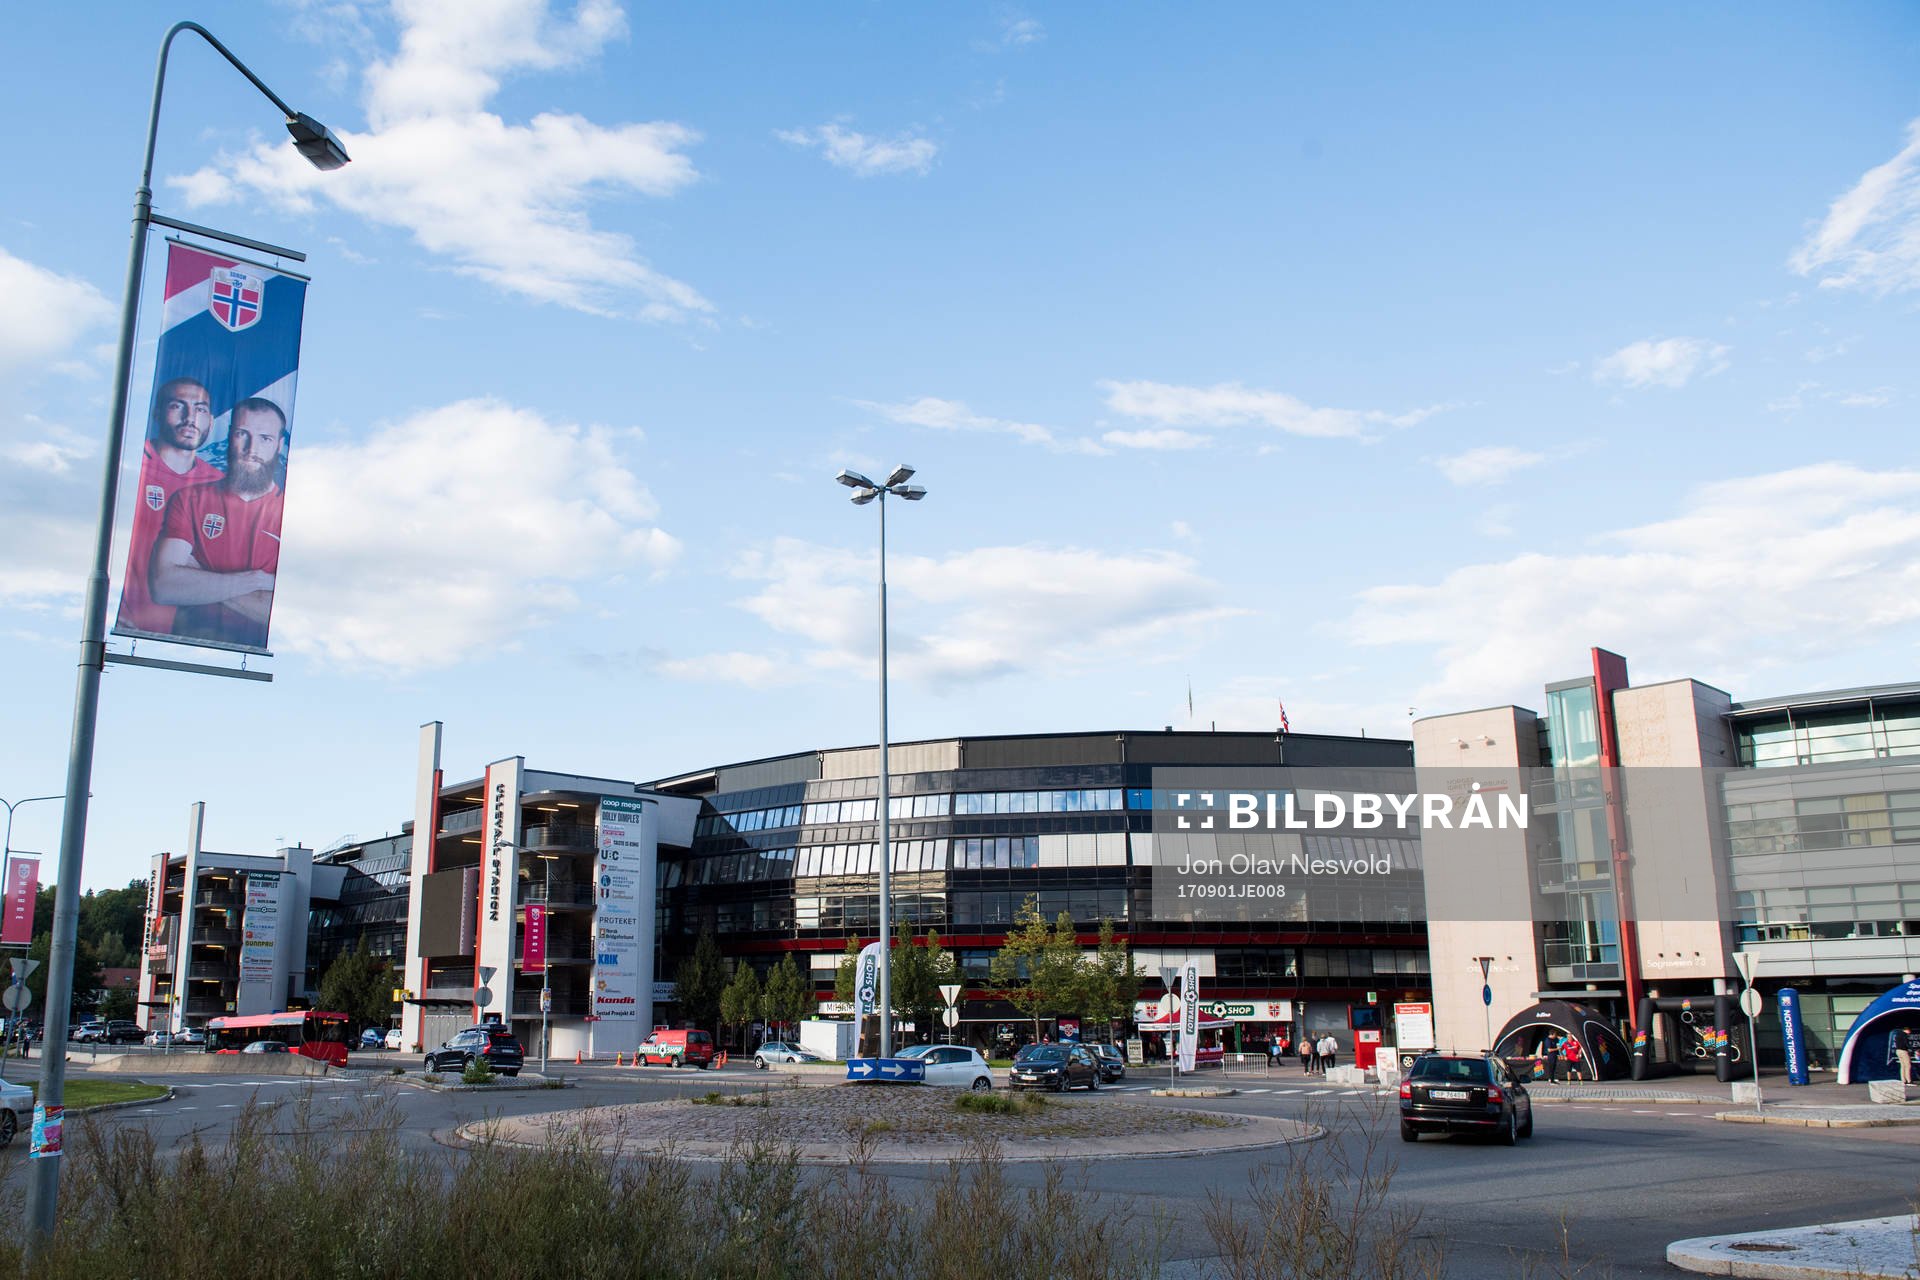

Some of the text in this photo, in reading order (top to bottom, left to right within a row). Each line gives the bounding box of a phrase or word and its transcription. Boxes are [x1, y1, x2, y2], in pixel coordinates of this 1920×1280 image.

[621, 802, 641, 810] mega
[489, 859, 501, 922] STADION
[865, 958, 874, 986] SHOP
[1188, 967, 1196, 990] SHOP
[1227, 1006, 1252, 1015] SHOP
[666, 1045, 683, 1054] SHOP
[1783, 1009, 1798, 1074] NORSK TIPPING
